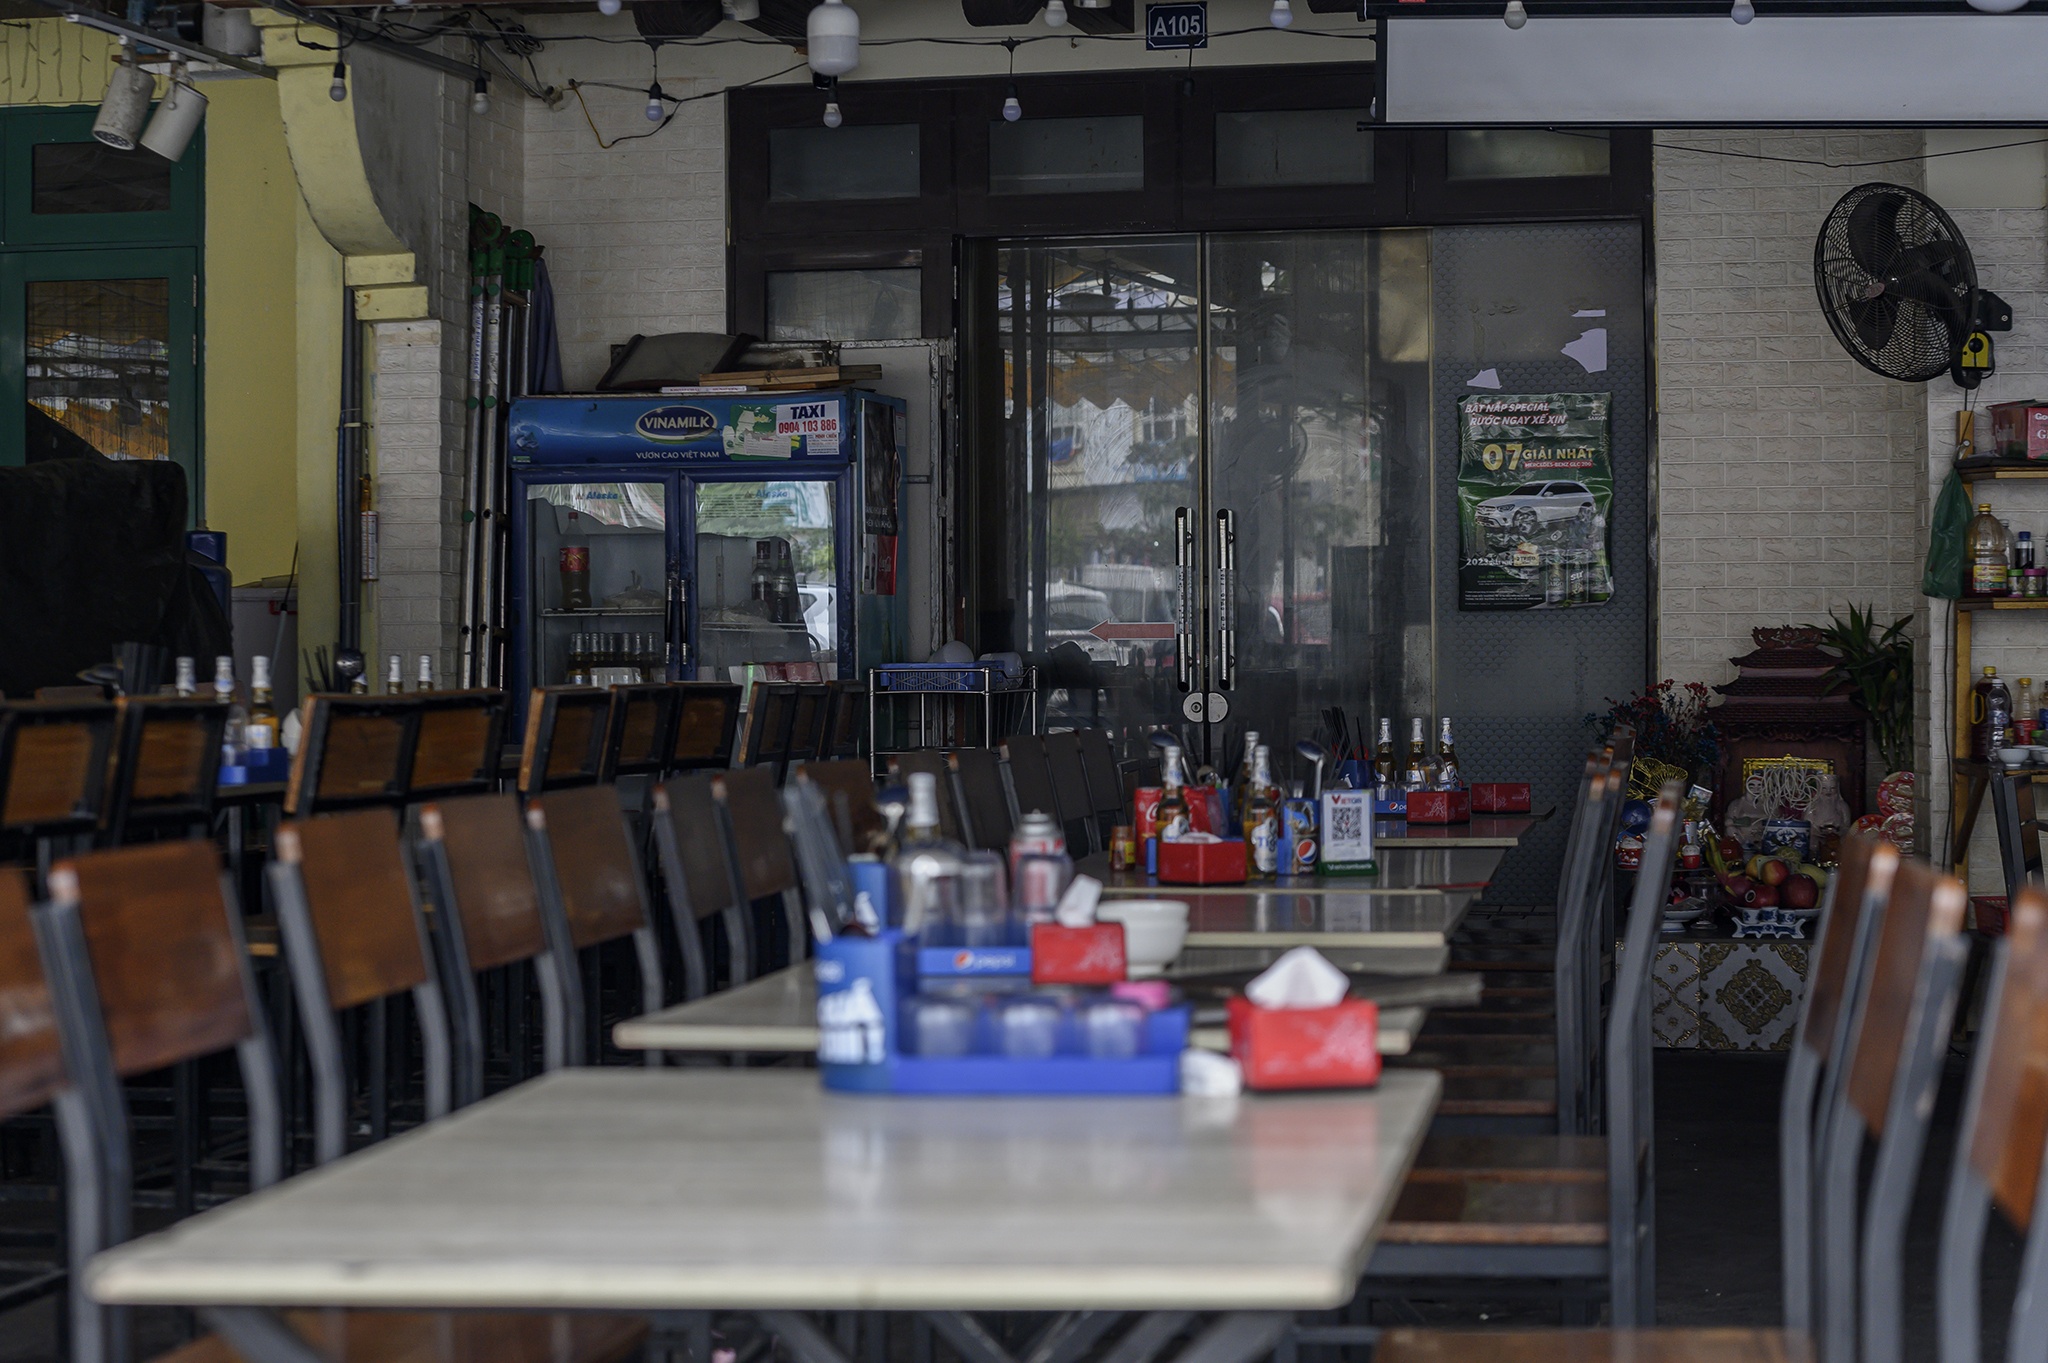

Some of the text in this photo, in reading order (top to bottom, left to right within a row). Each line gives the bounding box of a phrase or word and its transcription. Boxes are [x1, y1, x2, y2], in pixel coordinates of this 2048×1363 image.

[1153, 15, 1201, 37] A105
[790, 404, 825, 420] TAXI
[1507, 402, 1550, 413] SPECIAL
[644, 415, 710, 429] VINAMILK
[778, 418, 837, 434] 0904 103 886
[1500, 415, 1531, 425] NGAY
[635, 449, 720, 460] VƯƠN CAO VIỆT NAM
[1482, 443, 1523, 471] 07
[1522, 445, 1552, 460] GIẢI
